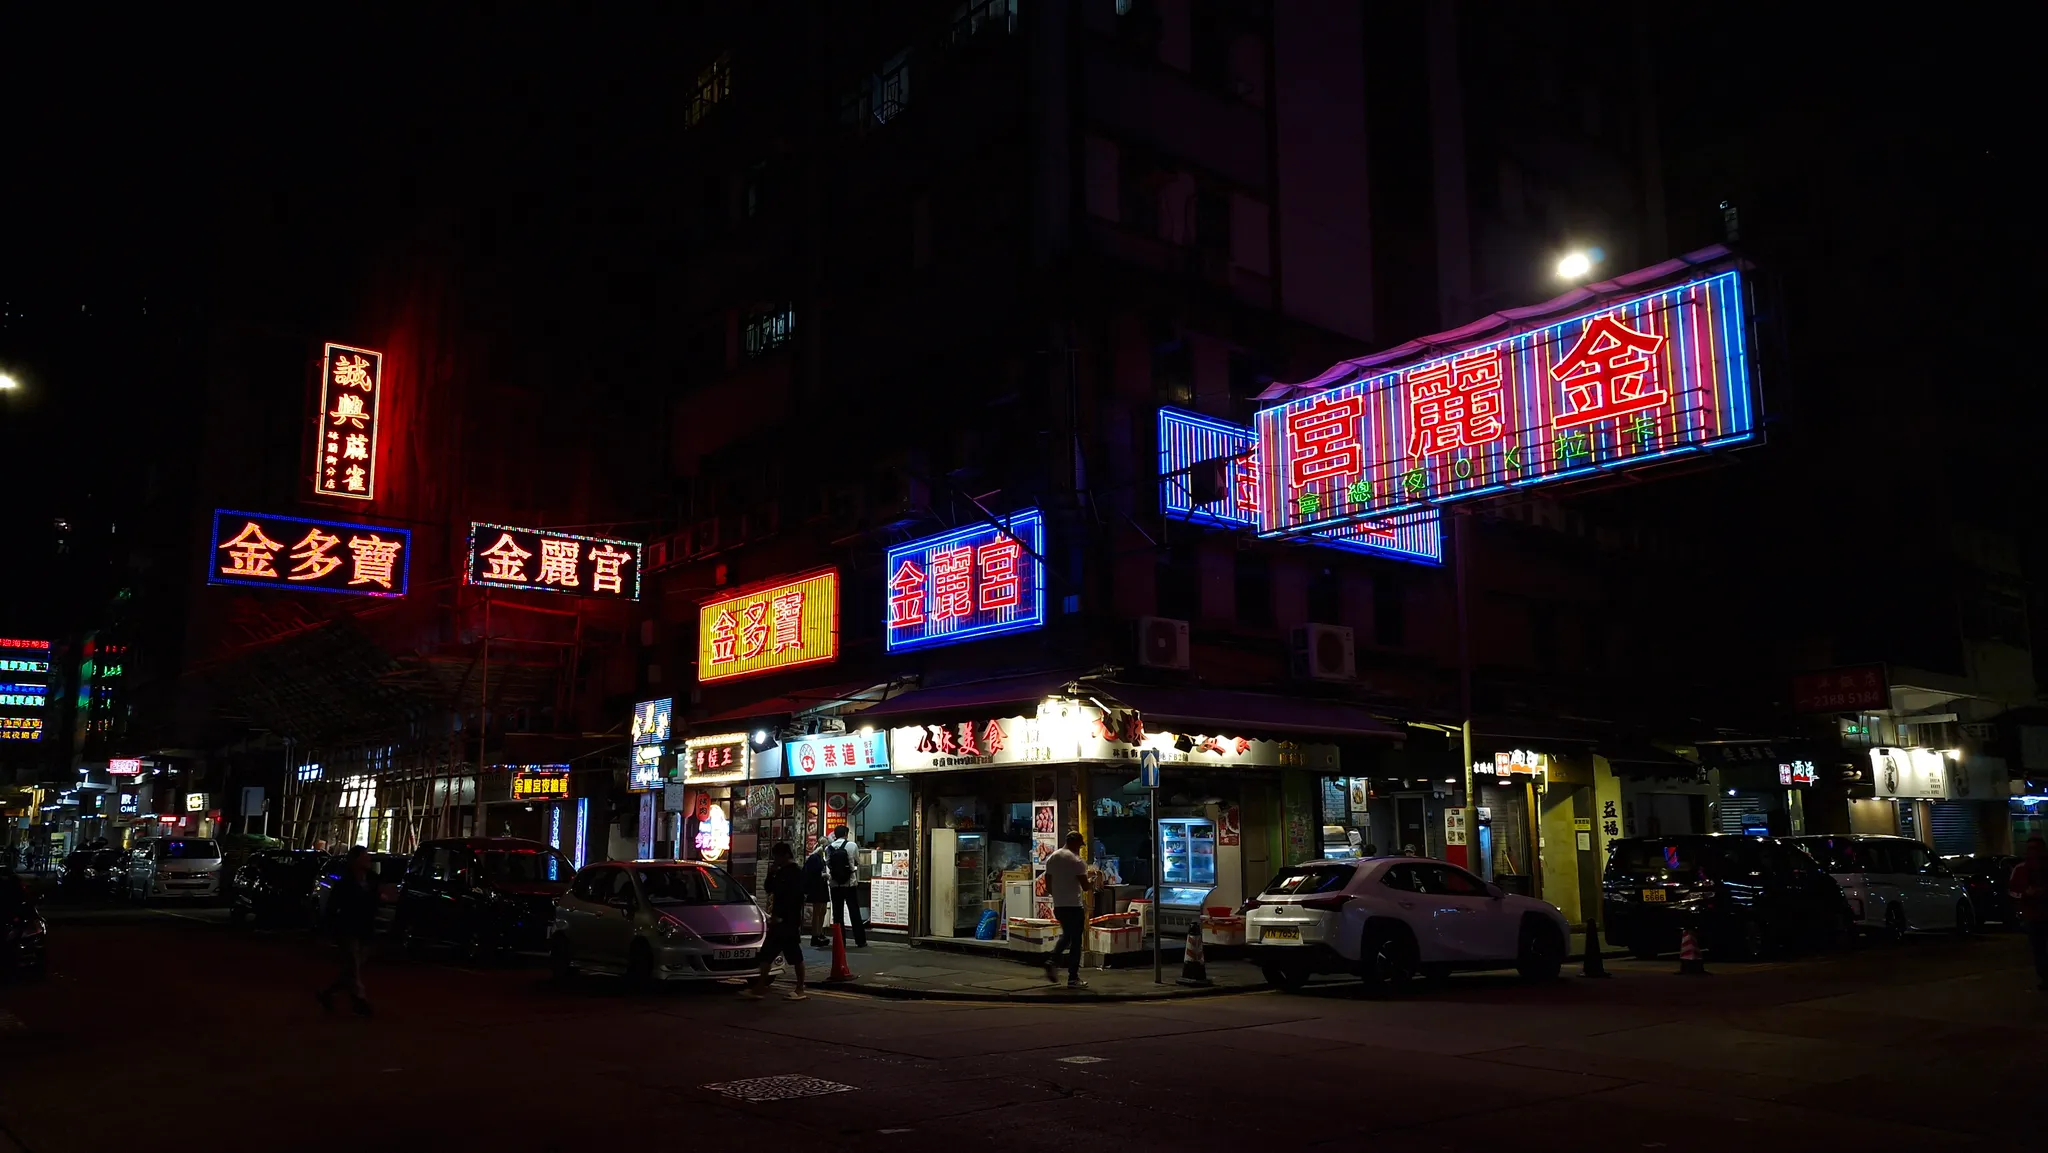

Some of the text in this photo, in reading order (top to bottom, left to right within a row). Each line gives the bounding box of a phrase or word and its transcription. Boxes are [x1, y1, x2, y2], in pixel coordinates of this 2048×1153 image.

[219, 522, 402, 589] 金多寶
[480, 533, 632, 593] 金麗宮
[889, 538, 1020, 628] 金麗宮
[710, 590, 805, 666] 金多寶
[823, 742, 857, 768] 蒸道
[514, 778, 568, 793] 金麗宮夜總會
[719, 949, 751, 959] ND 852
